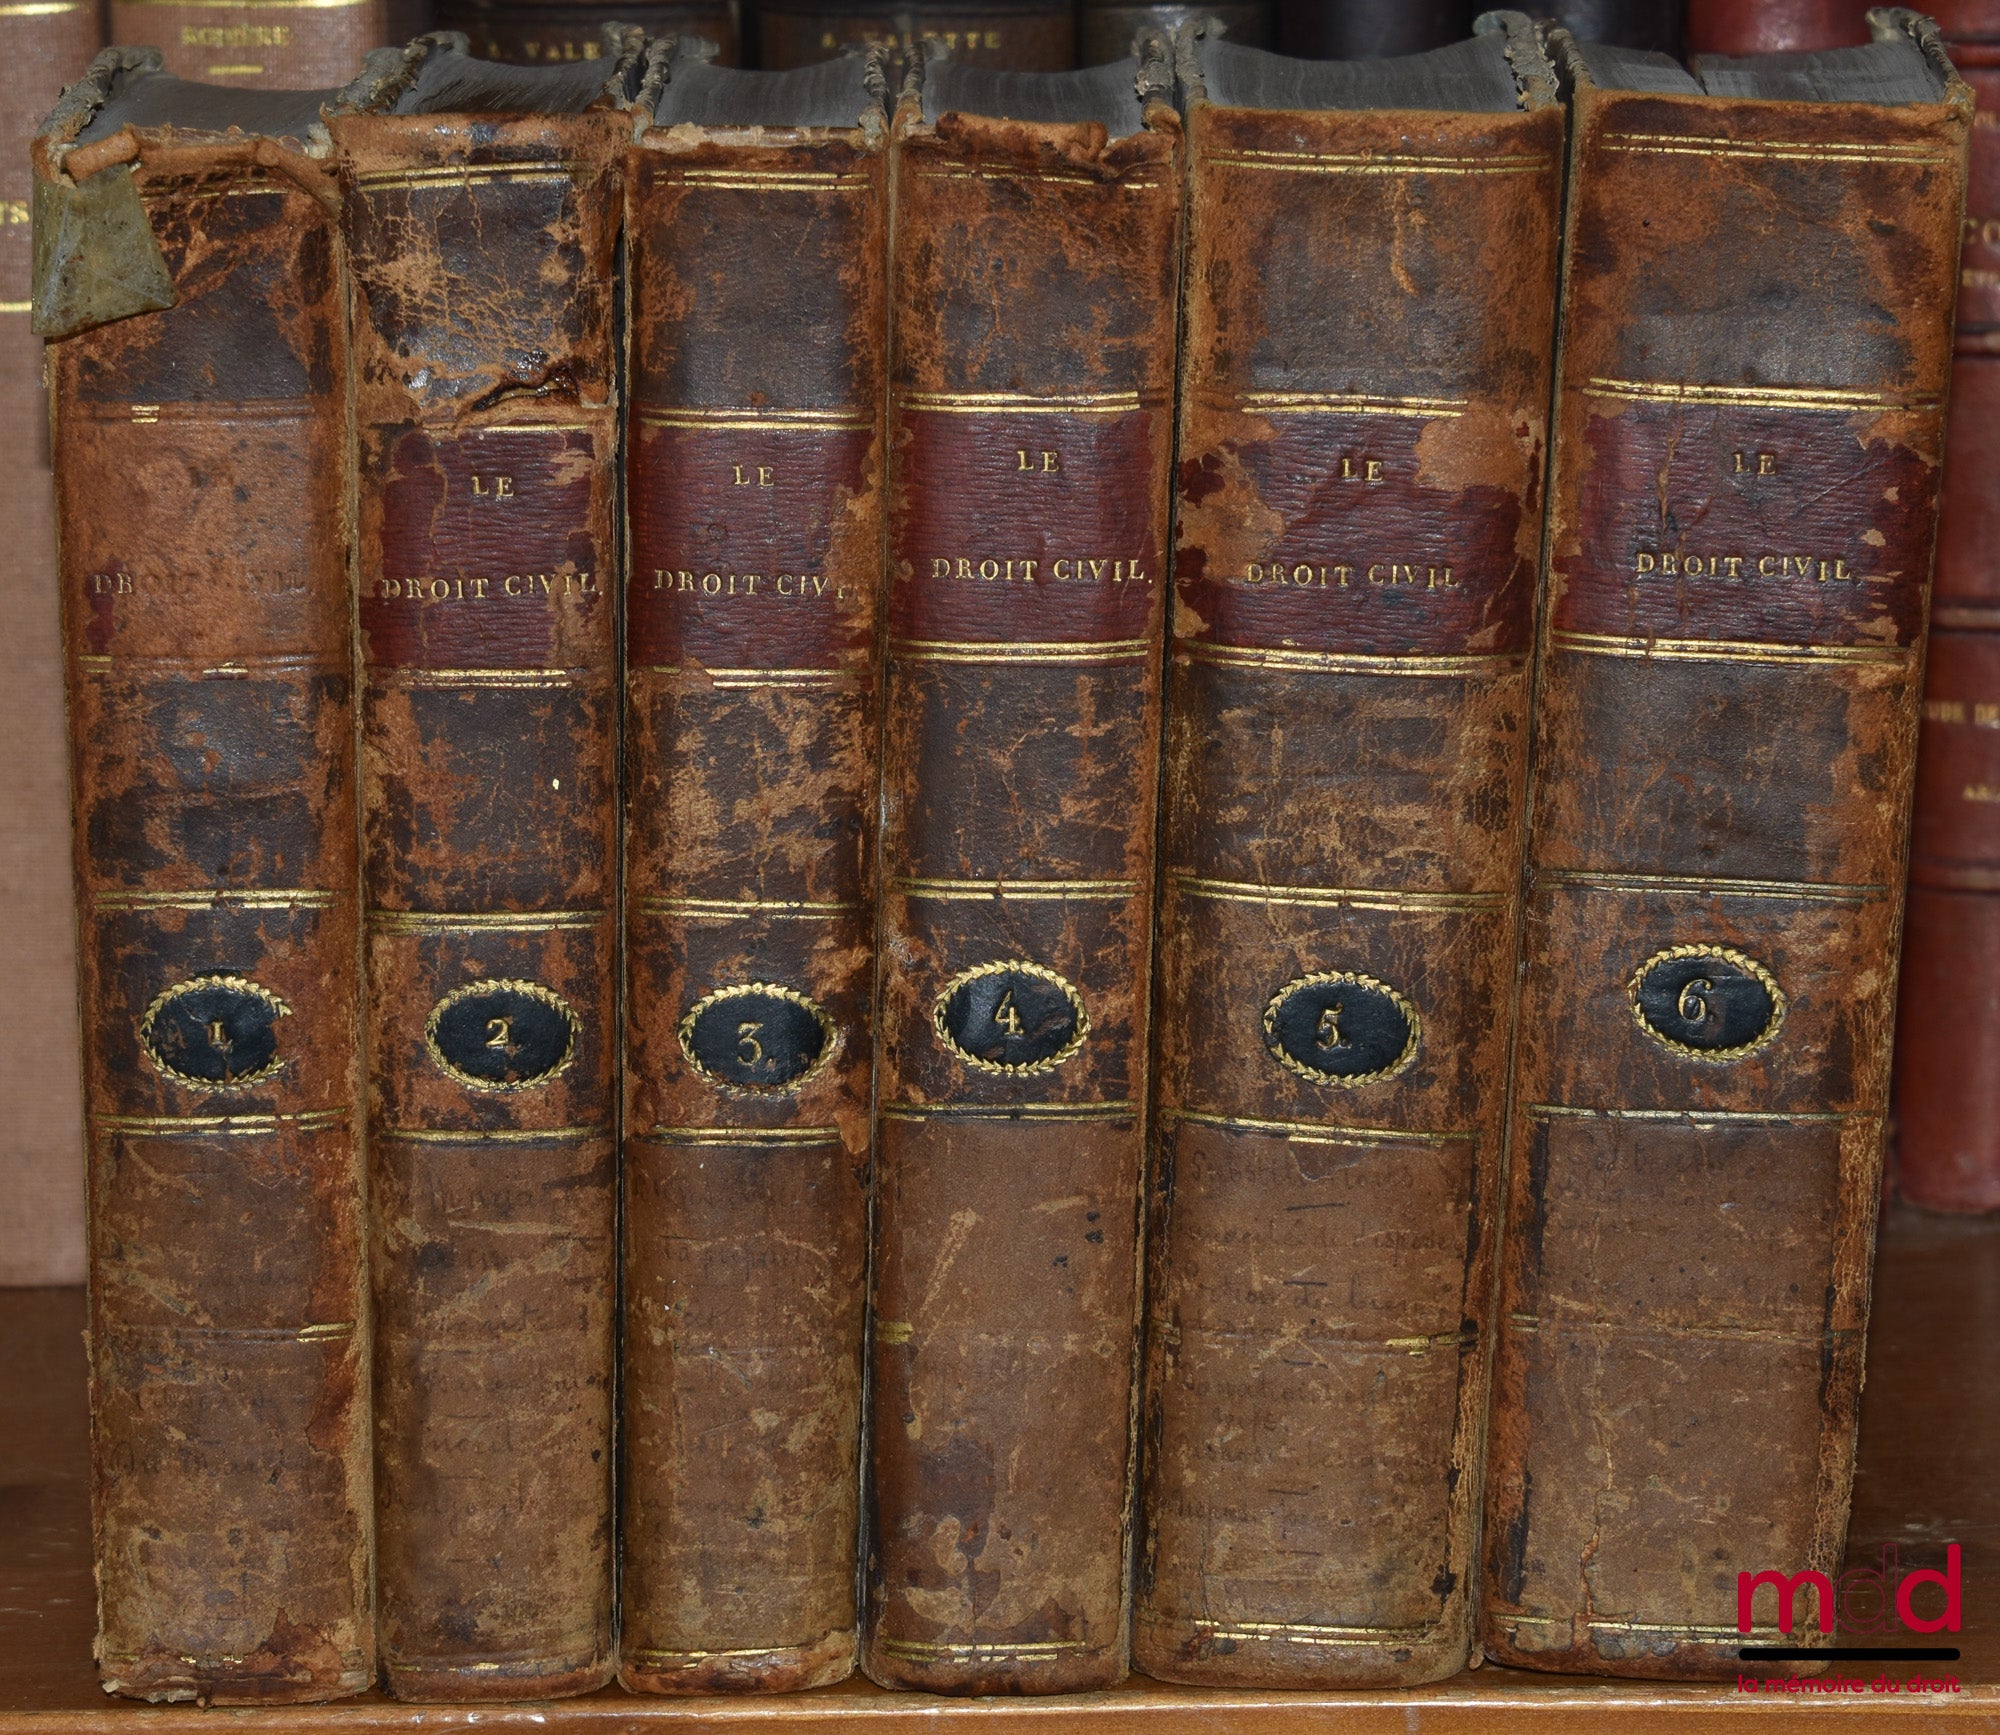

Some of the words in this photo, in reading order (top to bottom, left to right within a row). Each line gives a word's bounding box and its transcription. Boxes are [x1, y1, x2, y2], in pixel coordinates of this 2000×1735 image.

[1017, 451, 1060, 472] LE
[1342, 458, 1383, 482] LE
[1733, 453, 1776, 475] LE
[471, 476, 514, 497] LE
[733, 465, 774, 487] LE
[931, 558, 1038, 581] DROIT
[1053, 559, 1153, 584] CIVIL.
[1247, 563, 1352, 588] DROIT
[1636, 553, 1743, 577] DROIT
[382, 578, 489, 599] DROIT
[654, 569, 760, 596] DROIT
[995, 990, 1024, 1034] 4
